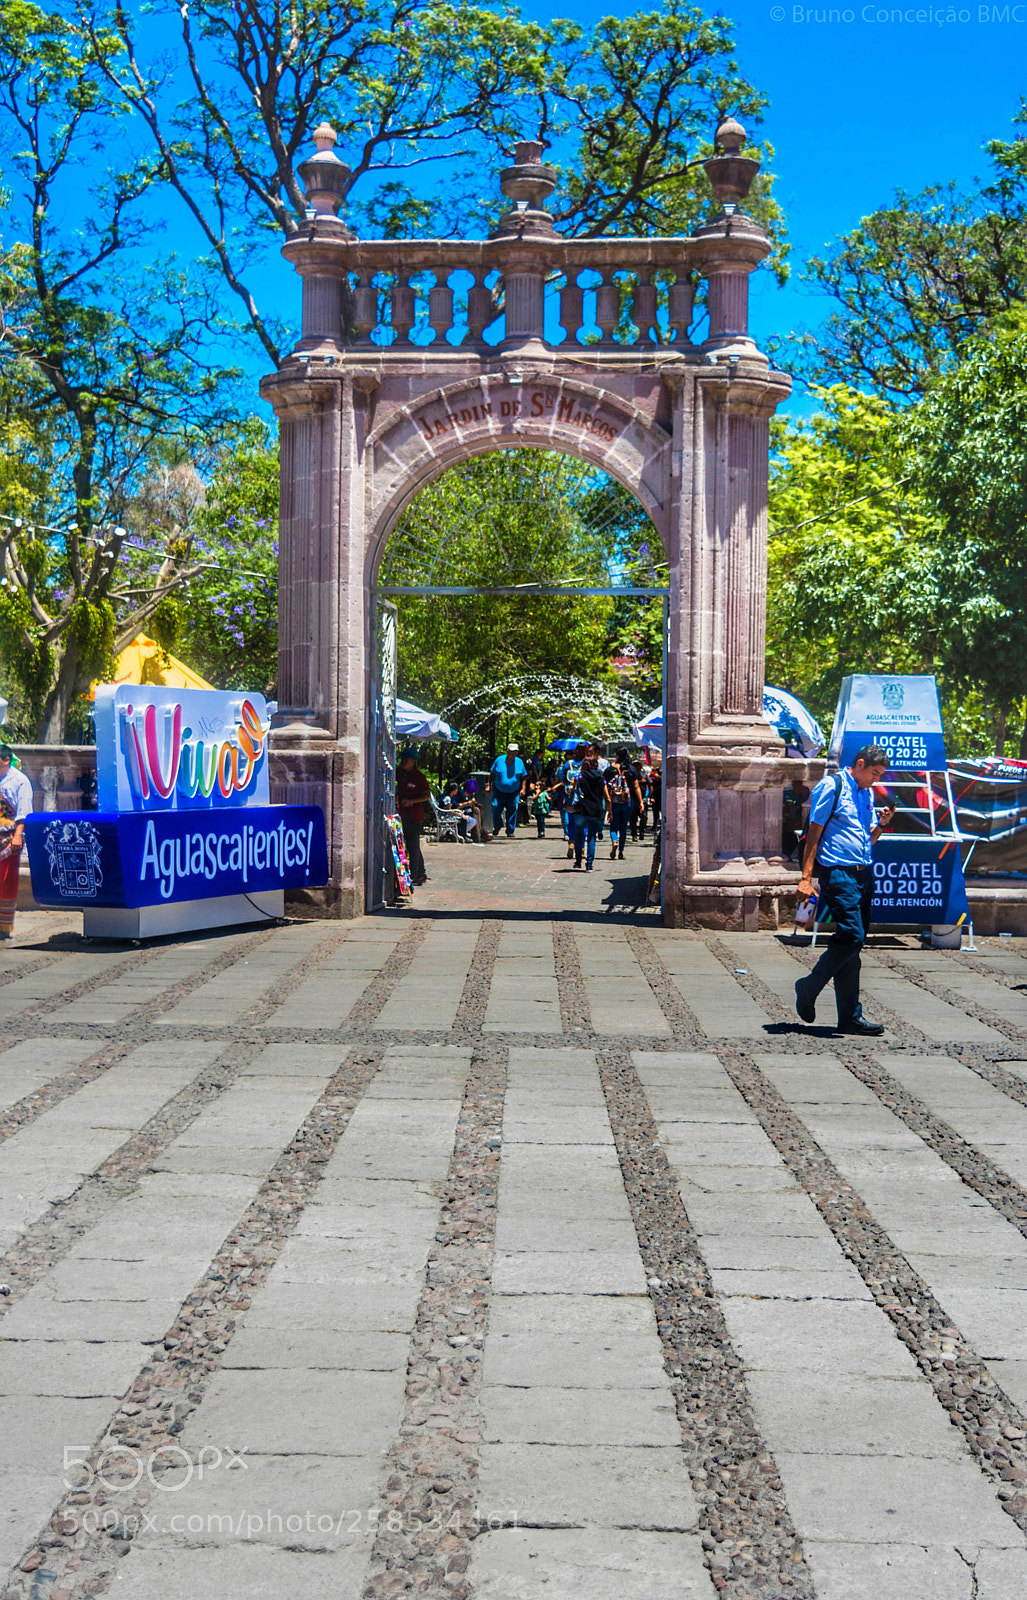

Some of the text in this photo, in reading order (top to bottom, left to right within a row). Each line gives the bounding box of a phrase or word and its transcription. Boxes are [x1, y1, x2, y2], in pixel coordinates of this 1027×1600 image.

[418, 401, 493, 441] JARDIN
[500, 399, 522, 418] DE
[556, 396, 620, 442] MARCOS
[873, 736, 927, 748] LOCATEL
[896, 748, 910, 758] 20
[912, 748, 927, 759] 20
[895, 759, 927, 767] ATENCIÓN
[140, 819, 314, 898] Aguascalientes!
[873, 862, 942, 879] OCATEL
[874, 879, 942, 895] 10 20 20
[882, 898, 895, 906] DE
[895, 896, 943, 907] ATENCIÓN
